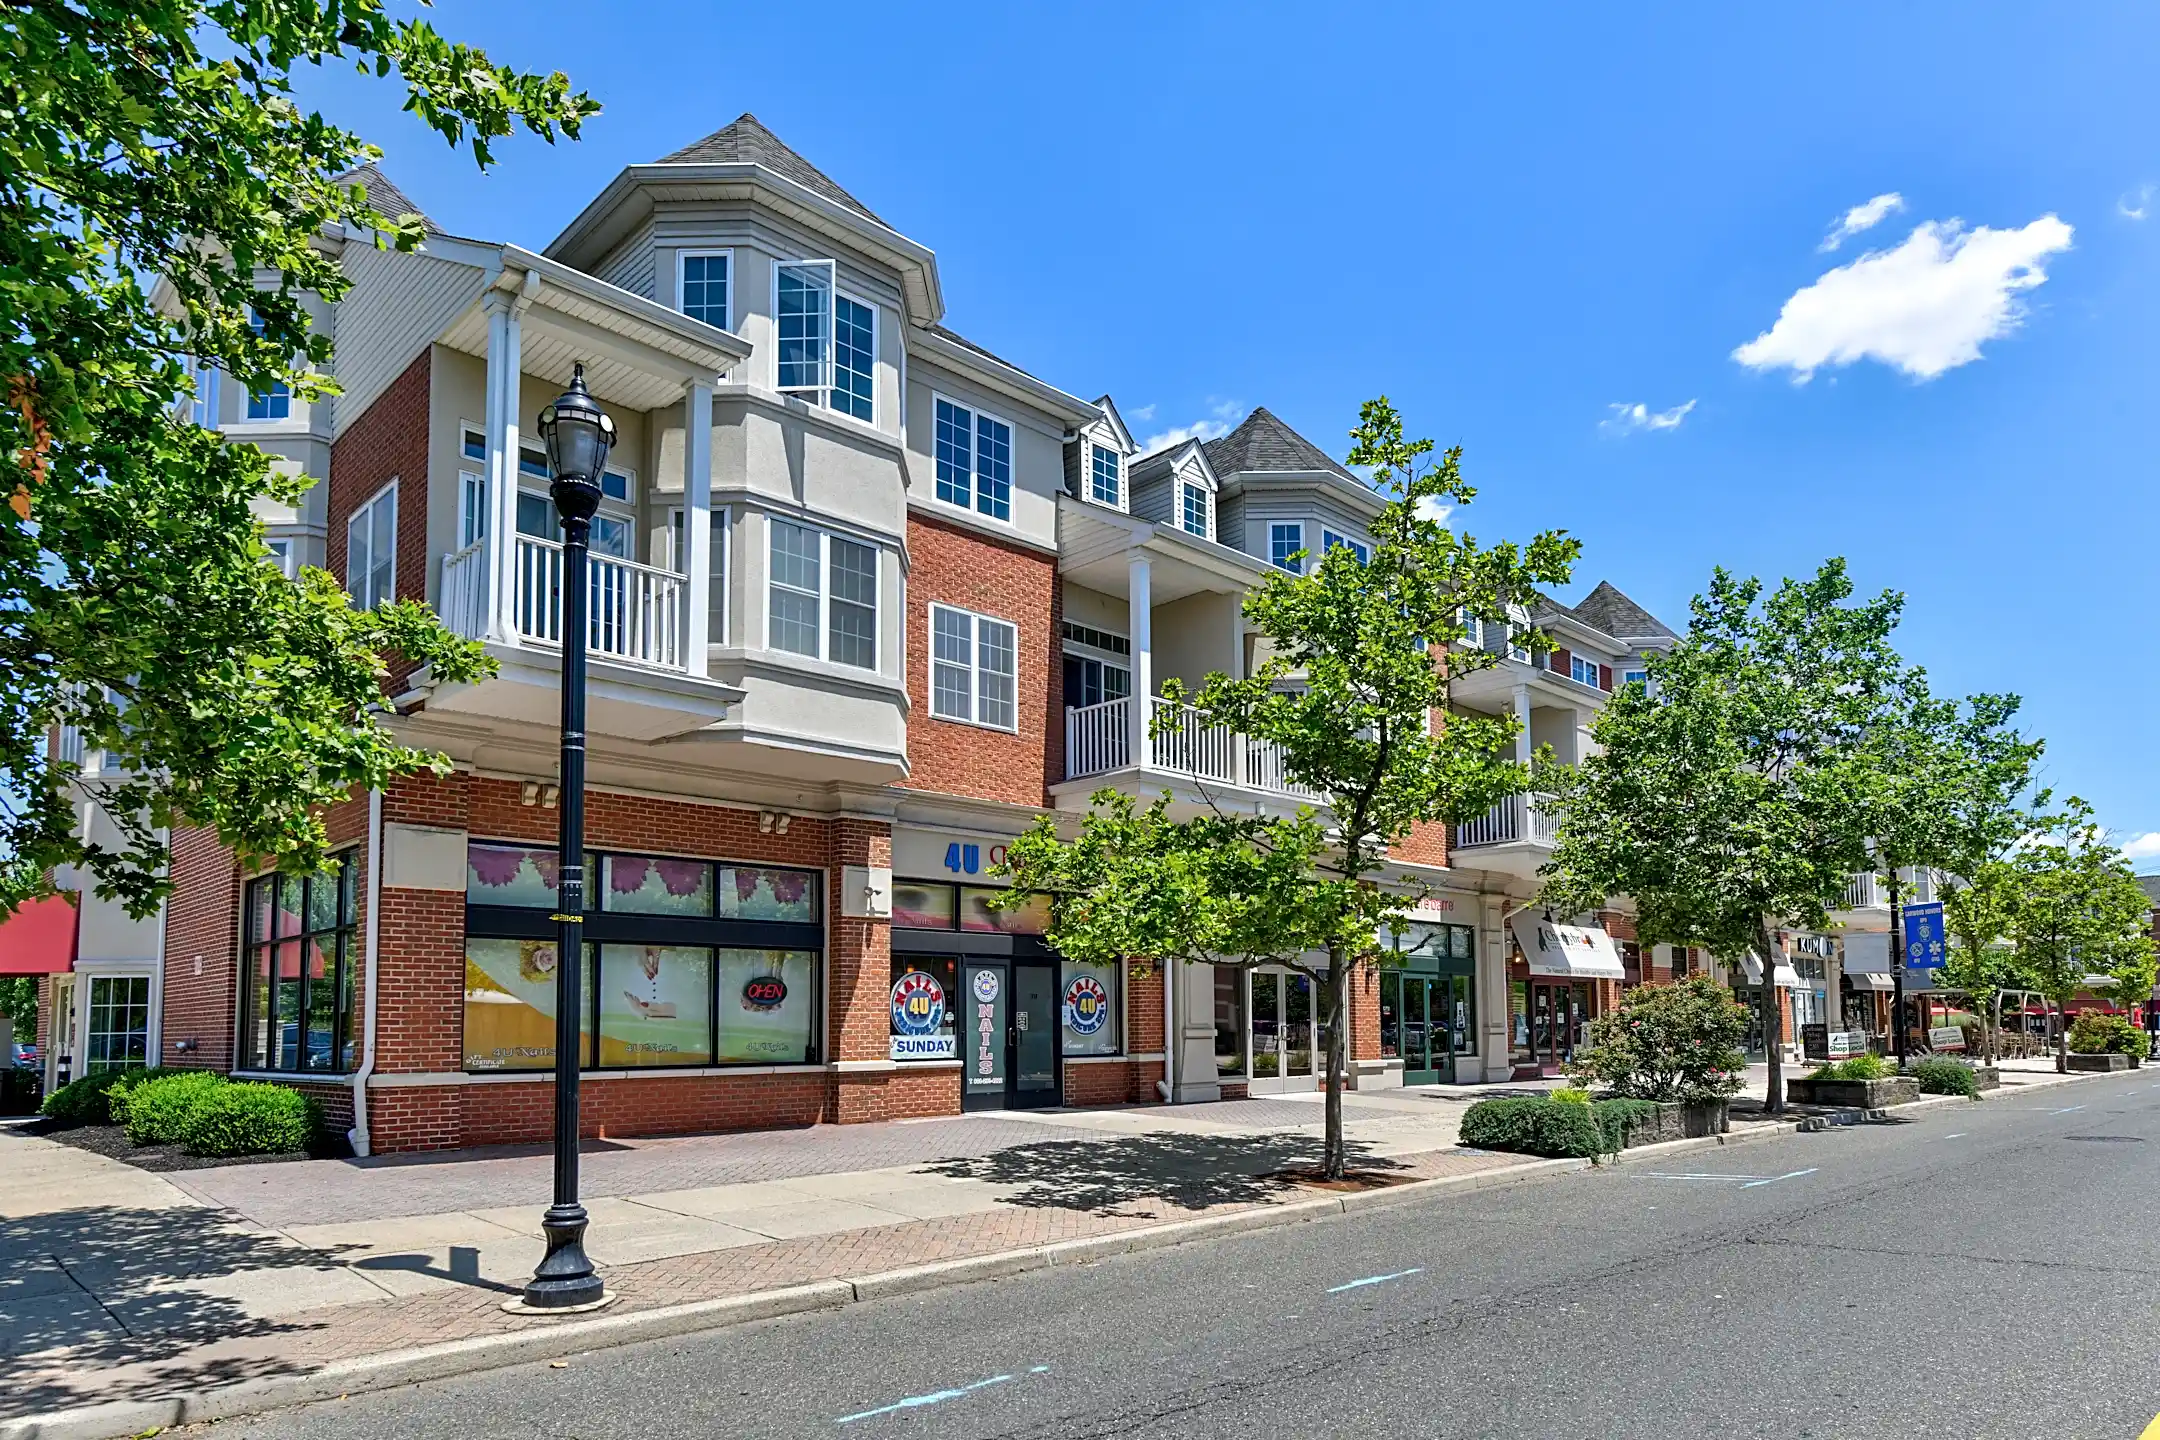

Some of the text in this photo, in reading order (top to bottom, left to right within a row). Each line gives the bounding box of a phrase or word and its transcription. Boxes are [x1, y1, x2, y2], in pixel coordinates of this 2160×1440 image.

[944, 842, 980, 875] 4U
[1800, 936, 1834, 958] KUMON
[748, 984, 784, 998] OPEN
[894, 975, 942, 1006] NAILS
[1066, 978, 1106, 1004] NAILS
[909, 997, 930, 1014] 4U
[1079, 998, 1096, 1014] 4U
[896, 1040, 953, 1052] SUNDAY
[978, 1004, 994, 1074] NAILS
